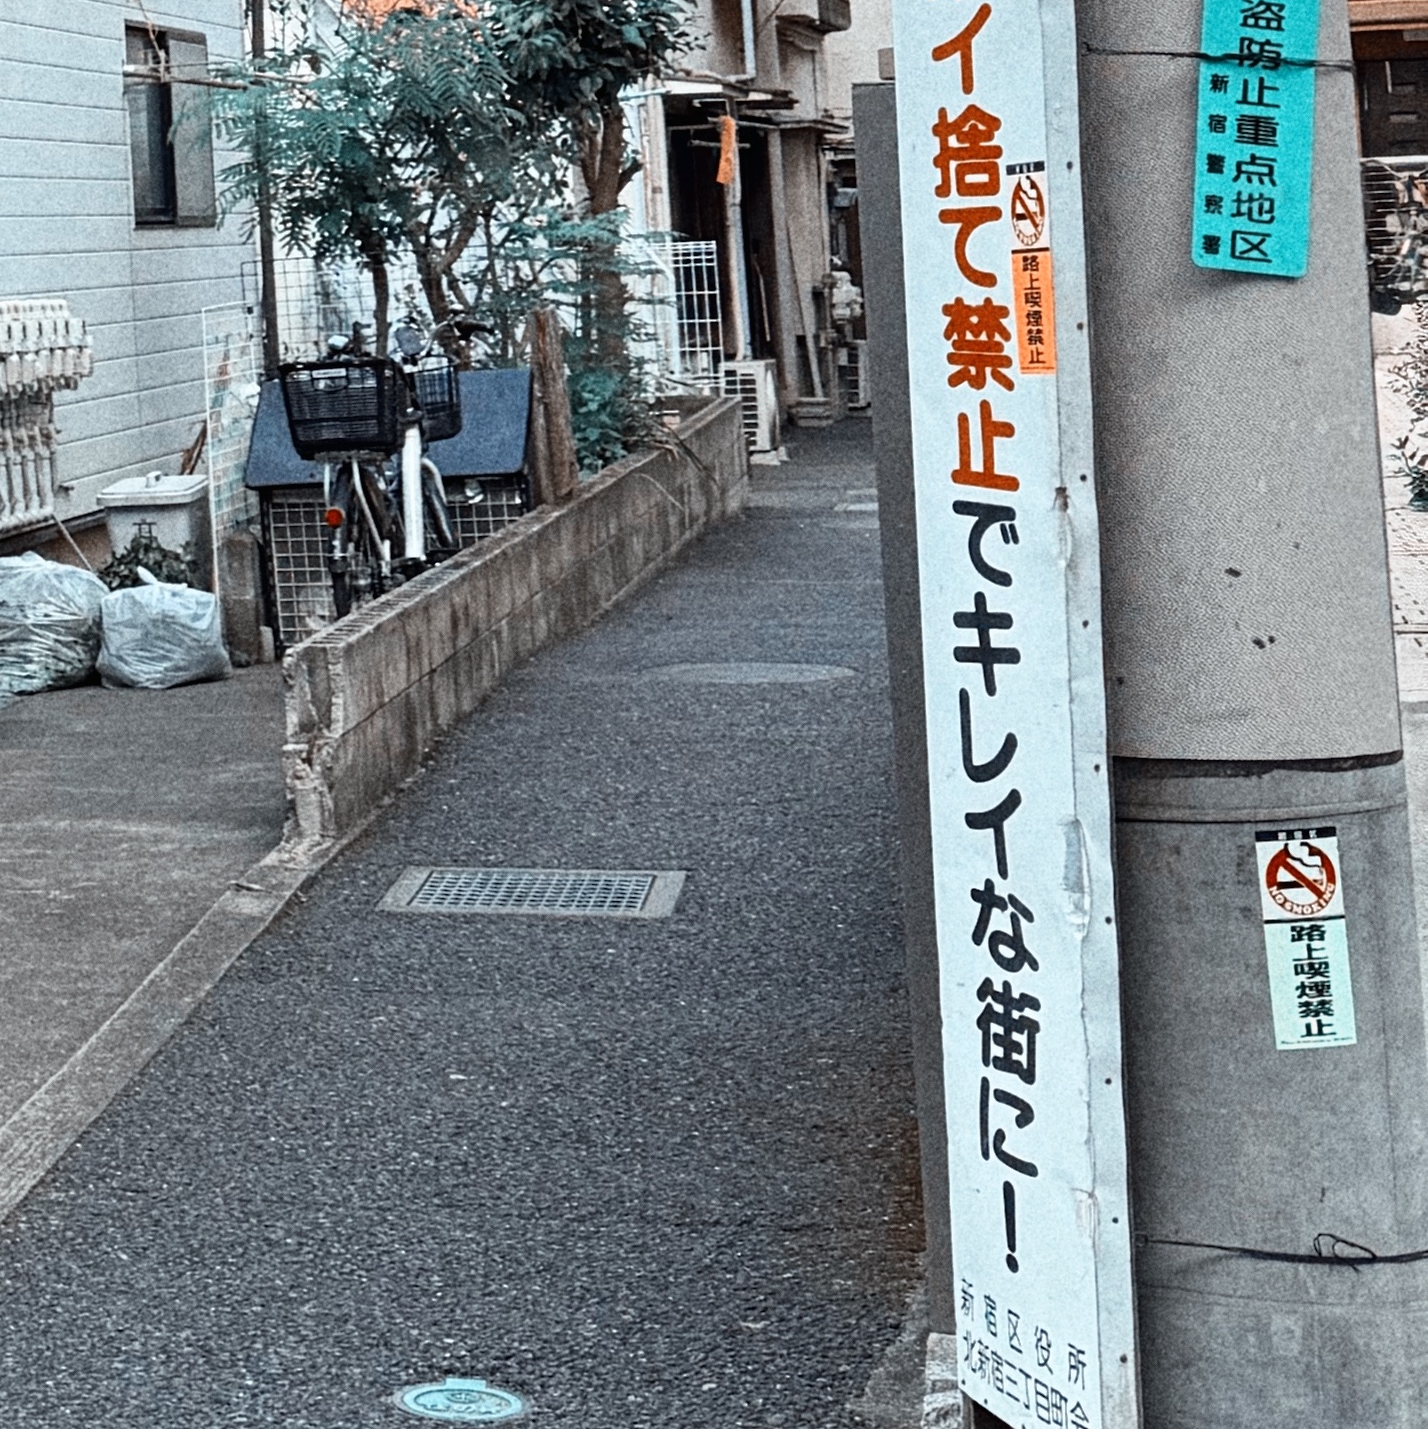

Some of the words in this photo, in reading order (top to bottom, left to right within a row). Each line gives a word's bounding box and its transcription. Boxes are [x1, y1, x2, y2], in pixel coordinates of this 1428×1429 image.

[1202, 73, 1230, 256] 新宿警察署
[1022, 255, 1046, 364] 路上喫煙禁止
[1283, 882, 1335, 915] SMOKING
[1290, 924, 1337, 1038] 路上喫煙禁止
[960, 1278, 1087, 1390] 新宿区役所
